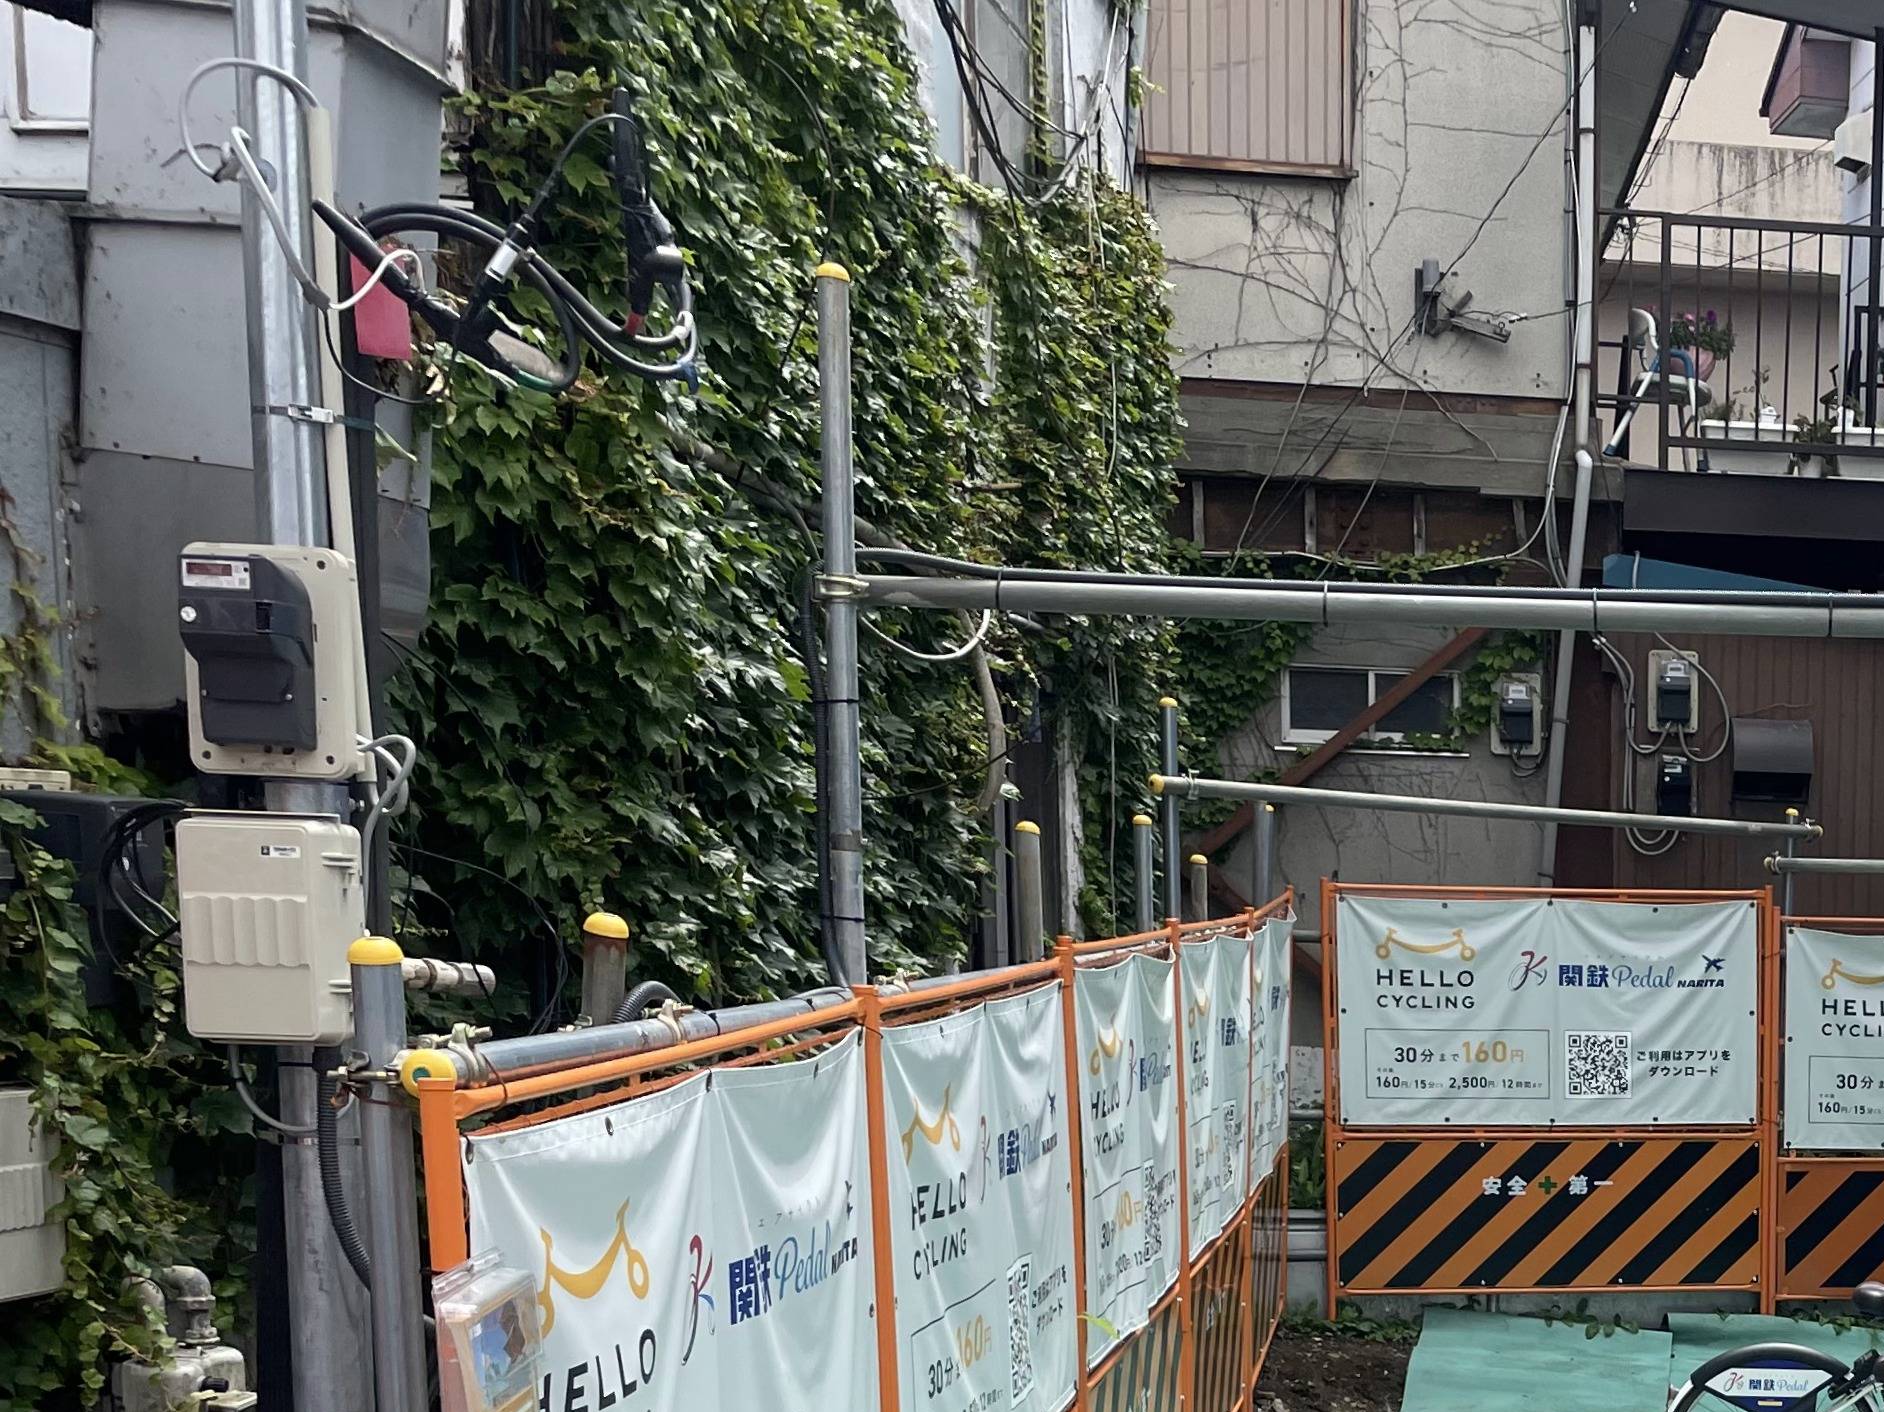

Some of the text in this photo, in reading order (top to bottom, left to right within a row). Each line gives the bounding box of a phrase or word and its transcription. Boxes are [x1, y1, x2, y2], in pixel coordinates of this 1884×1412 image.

[1376, 969, 1475, 988] HELLO
[1677, 979, 1725, 988] NARITA
[1376, 994, 1475, 1009] CYCLING
[1636, 1049, 1731, 1063] ご利用はアプリを
[1648, 1065, 1719, 1077] ダウンロード
[1481, 1173, 1614, 1198] 安全 第一
